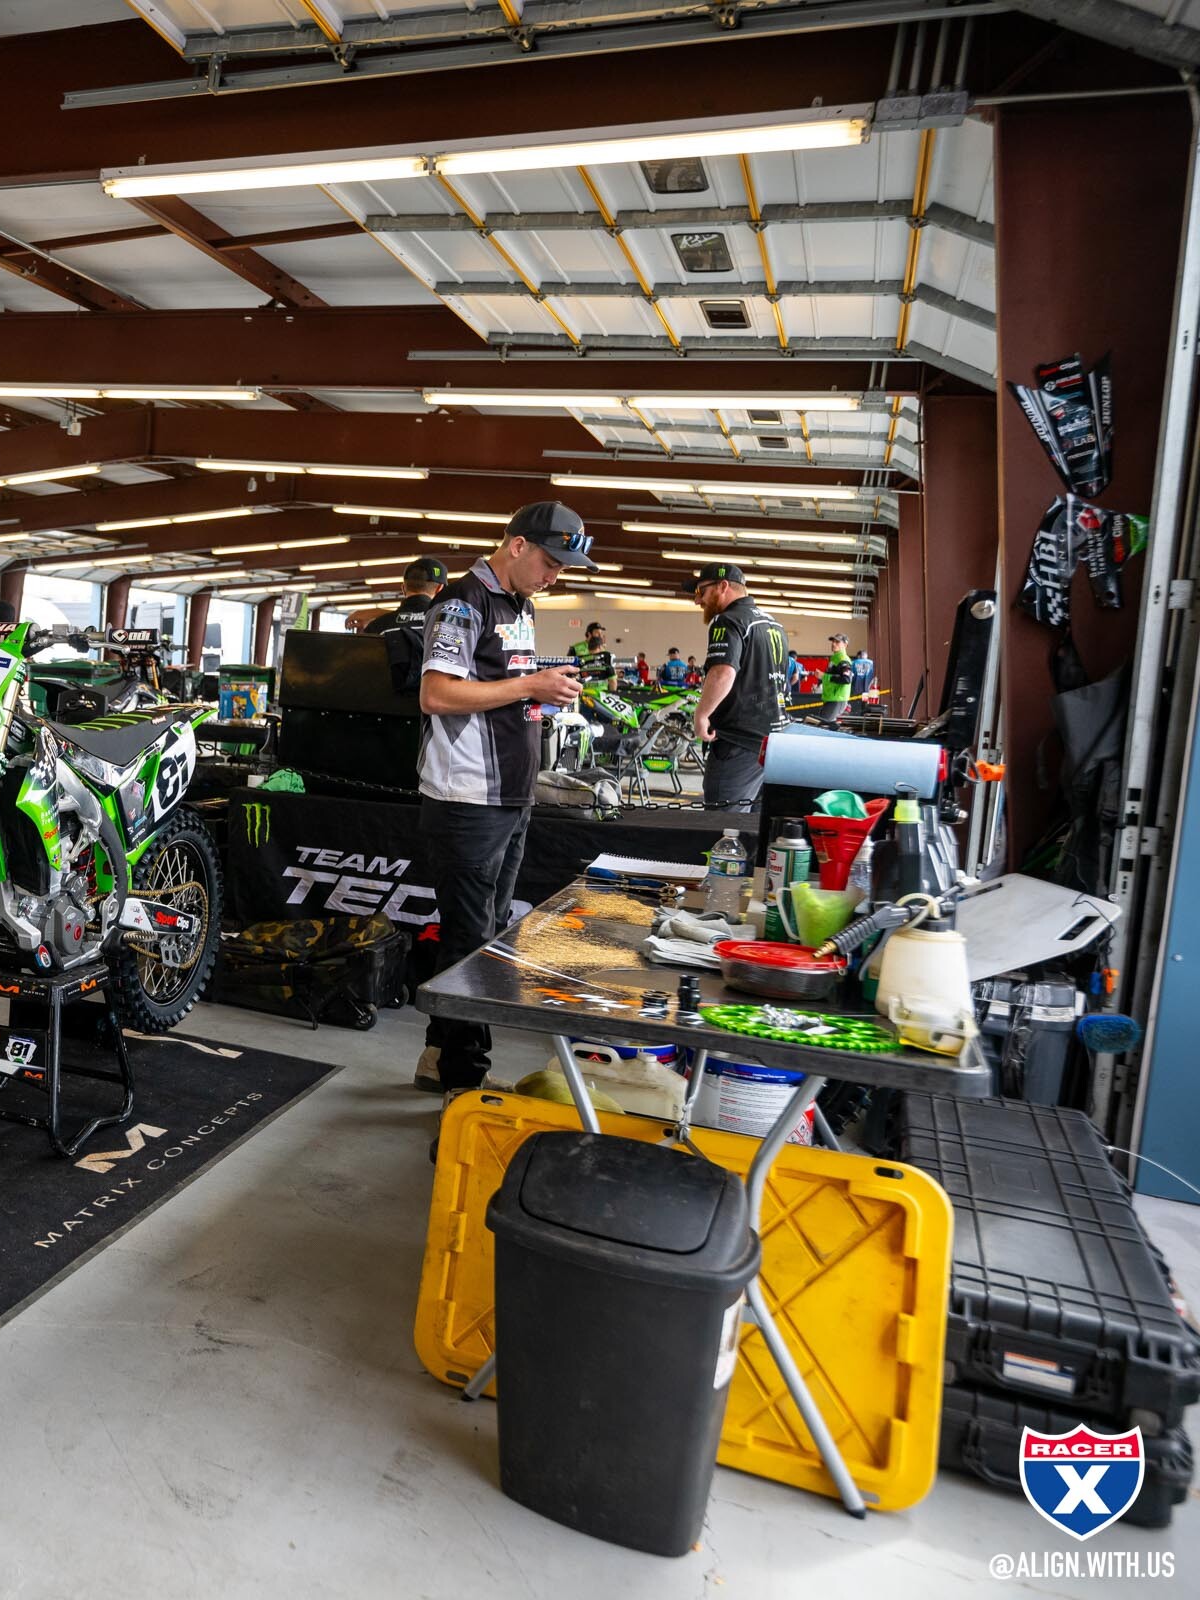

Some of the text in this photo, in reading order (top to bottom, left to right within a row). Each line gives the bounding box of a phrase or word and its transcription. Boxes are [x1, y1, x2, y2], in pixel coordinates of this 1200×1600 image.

[1020, 400, 1050, 442] DUNLOP
[604, 696, 626, 713] 519
[295, 845, 412, 877] TEAM
[9, 1041, 31, 1057] 81
[146, 1091, 264, 1171] CONCEPTS
[33, 1177, 144, 1249] MATRIX
